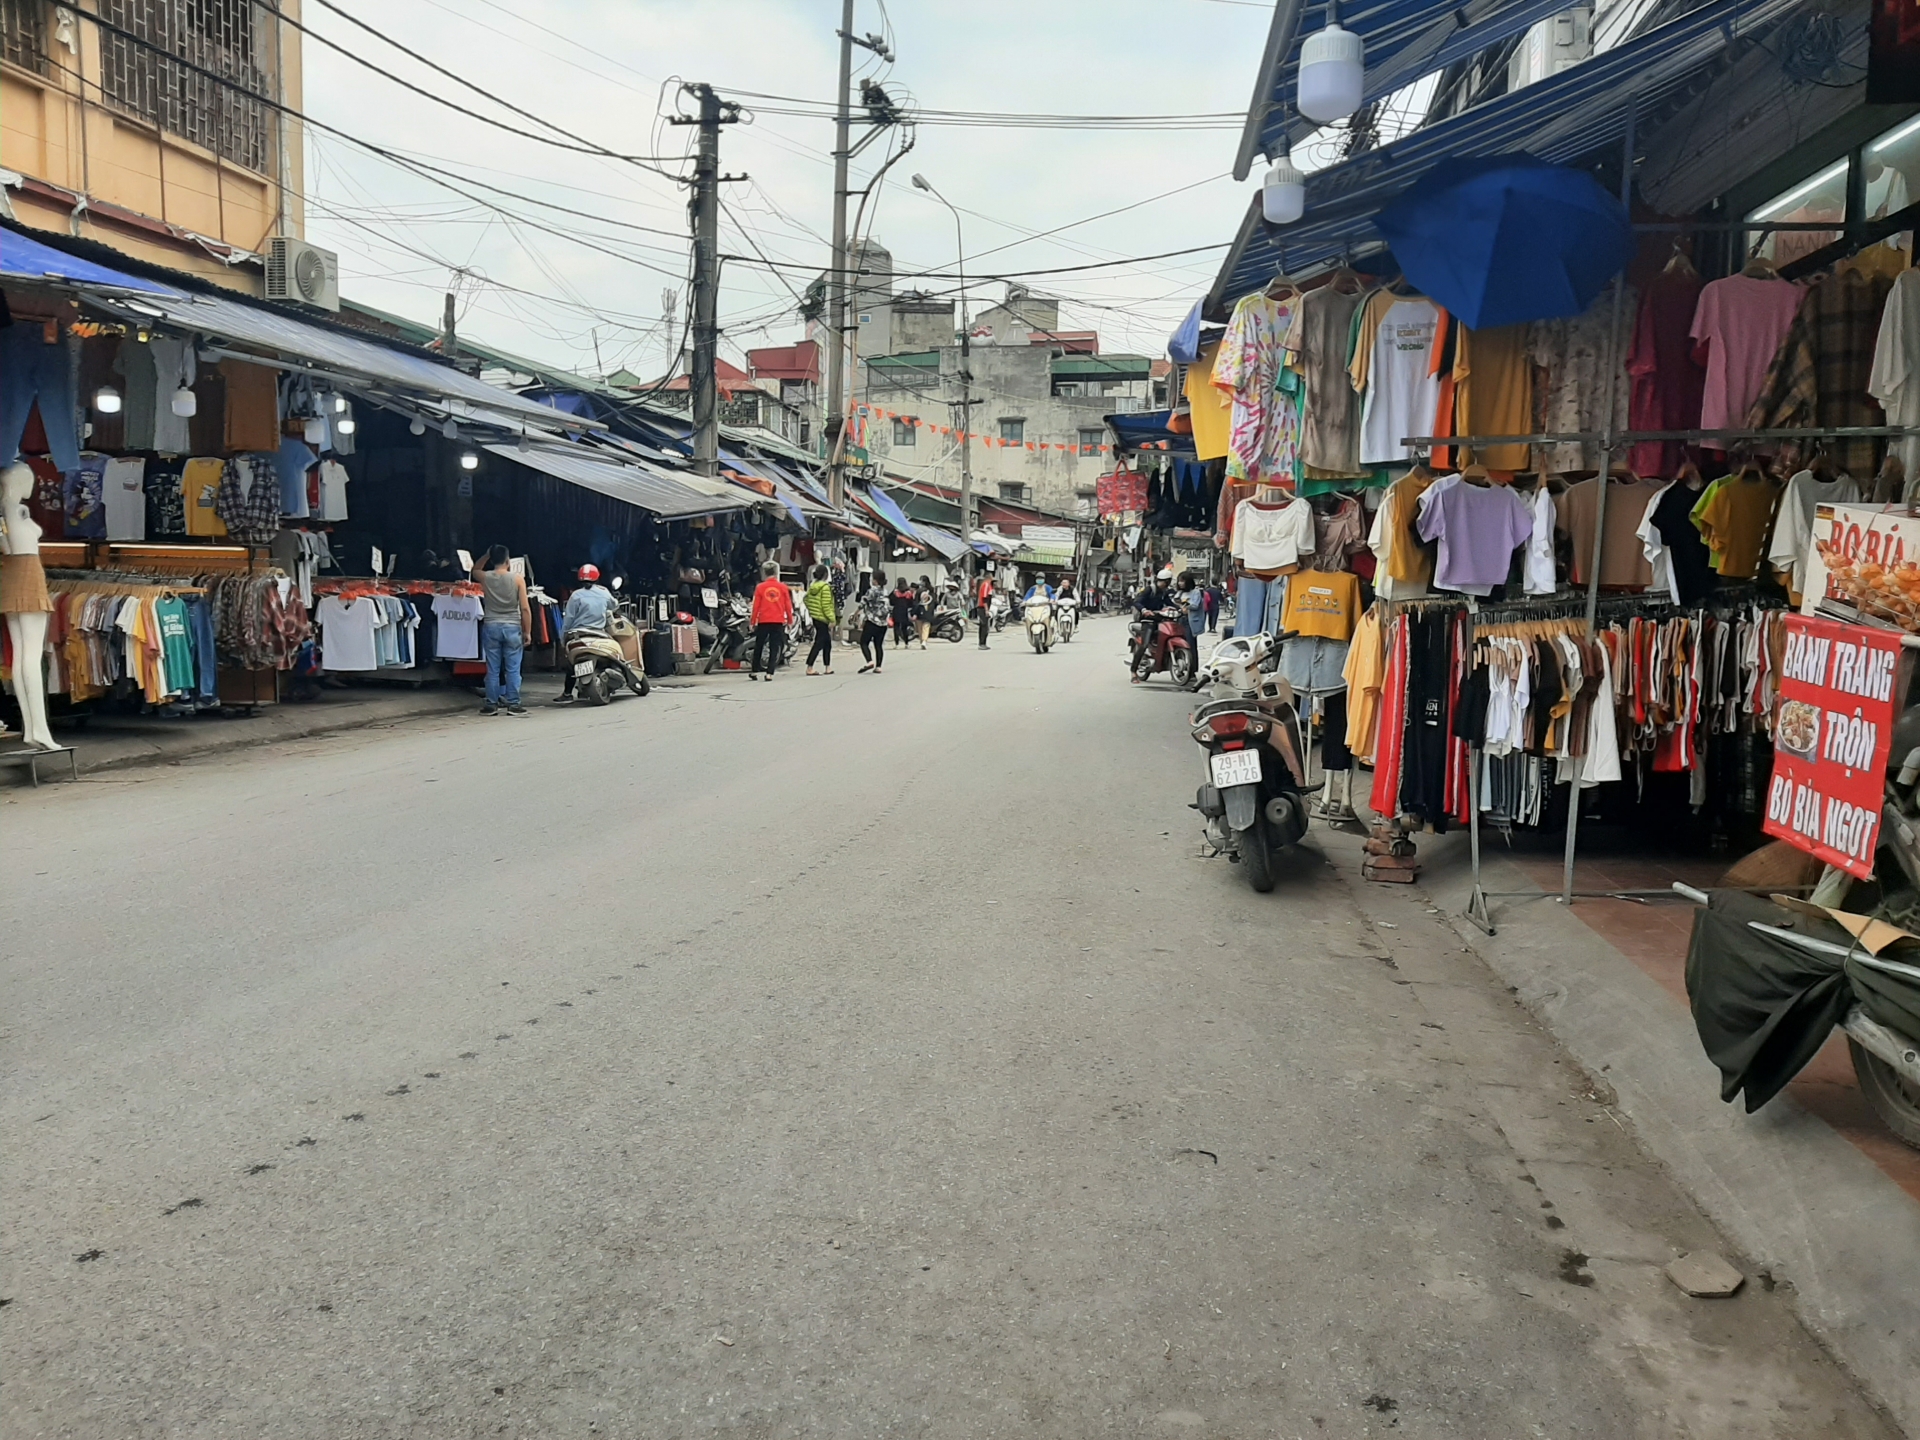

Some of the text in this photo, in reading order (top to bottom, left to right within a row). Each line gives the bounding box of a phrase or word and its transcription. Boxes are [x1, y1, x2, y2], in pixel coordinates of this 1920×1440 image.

[441, 610, 472, 621] ADIDAS
[1823, 707, 1877, 778] TRỘN
[1769, 768, 1877, 868] BÒ BÍA NGỌT
